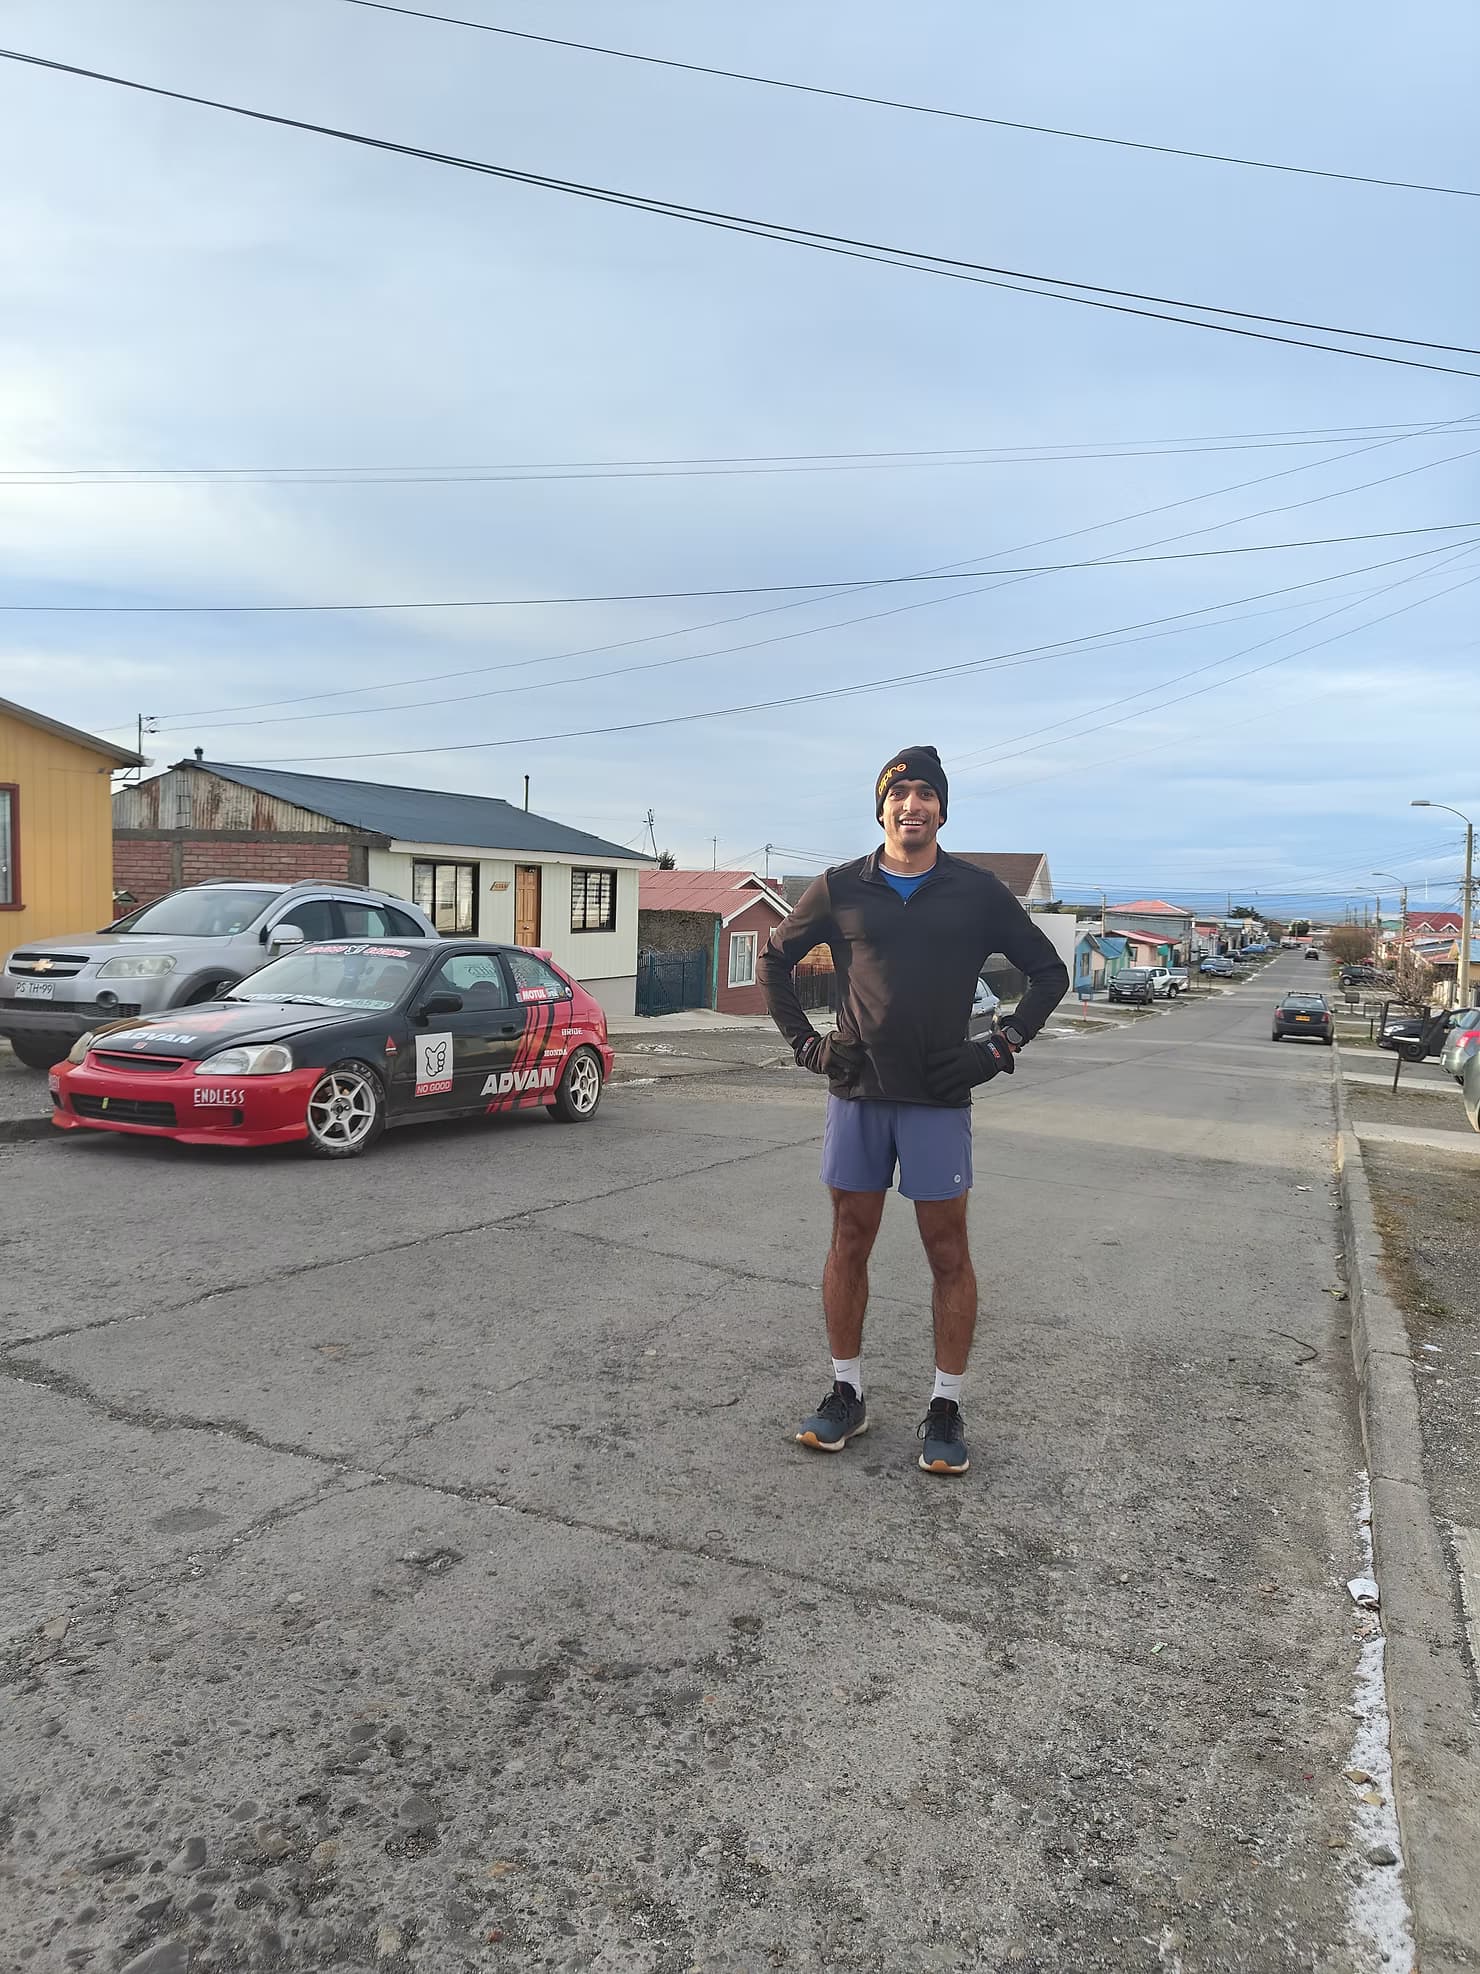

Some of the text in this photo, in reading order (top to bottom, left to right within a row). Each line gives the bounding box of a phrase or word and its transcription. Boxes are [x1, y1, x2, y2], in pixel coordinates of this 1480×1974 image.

[522, 989, 546, 1000] MOTUL
[114, 1032, 198, 1044] ADVAN
[562, 1028, 583, 1036] BRIDE
[544, 1048, 568, 1057] HONDA
[417, 1081, 451, 1094] NO GOOD
[480, 1067, 556, 1096] ADVAN
[194, 1088, 246, 1105] ENDLESS
